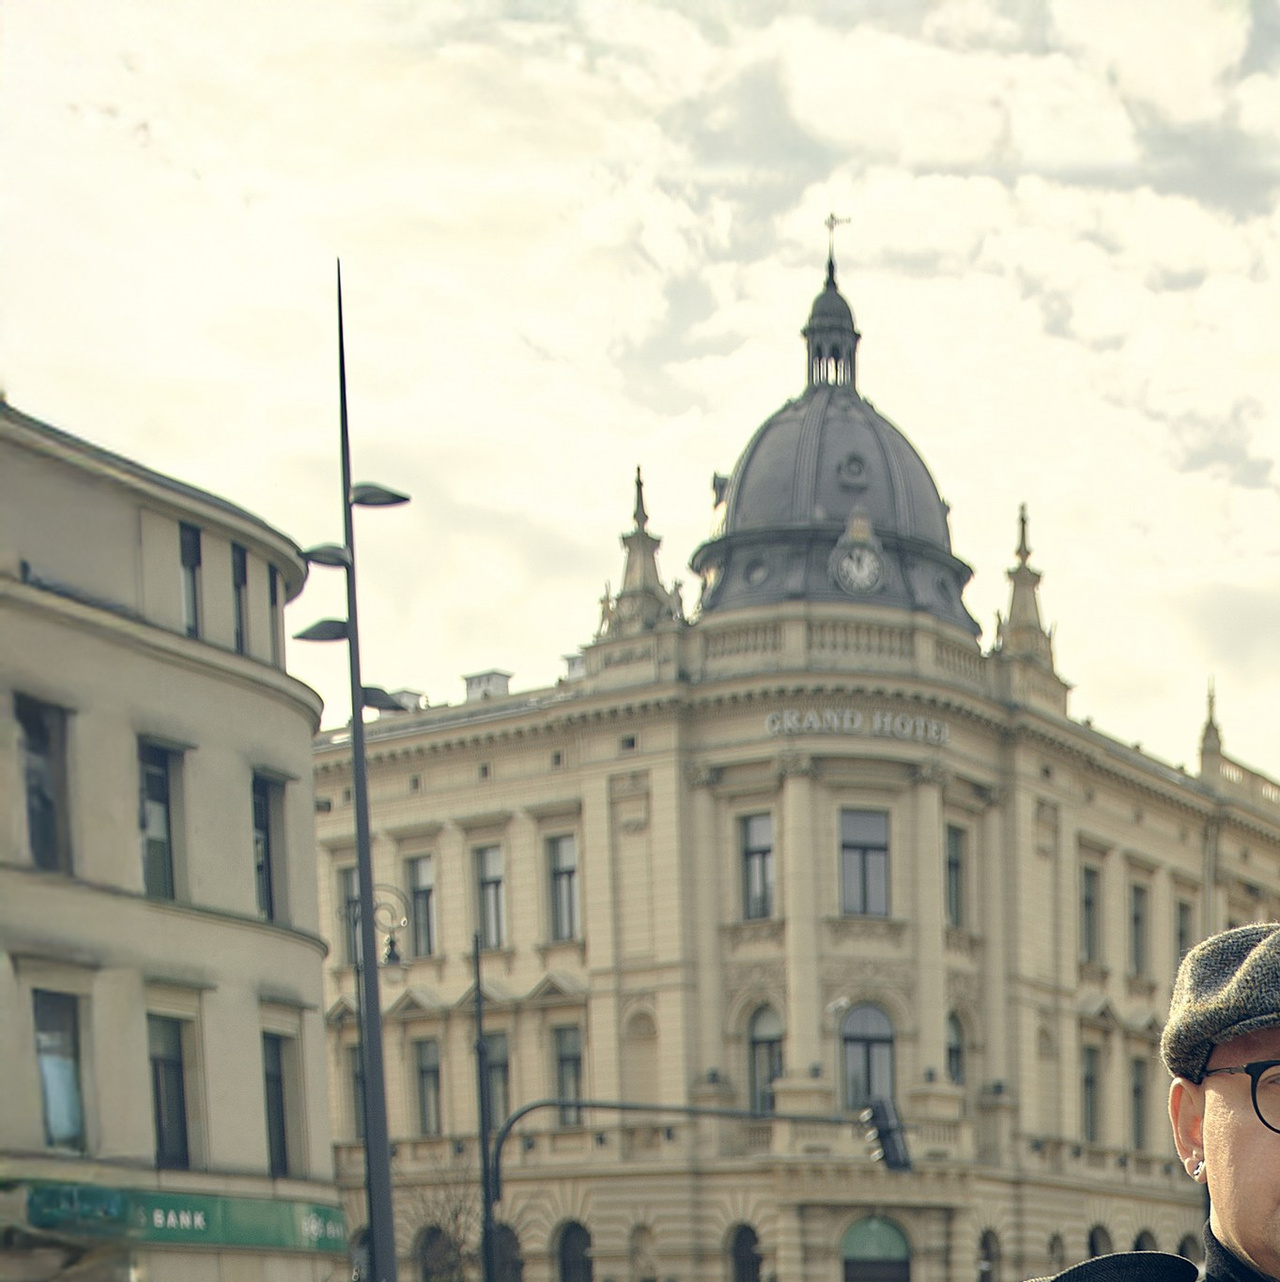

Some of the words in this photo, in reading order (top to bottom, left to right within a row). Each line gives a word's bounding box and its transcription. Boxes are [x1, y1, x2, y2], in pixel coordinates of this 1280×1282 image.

[766, 708, 862, 735] GRAND
[873, 710, 948, 744] HOTEL
[152, 1207, 206, 1231] BANK
